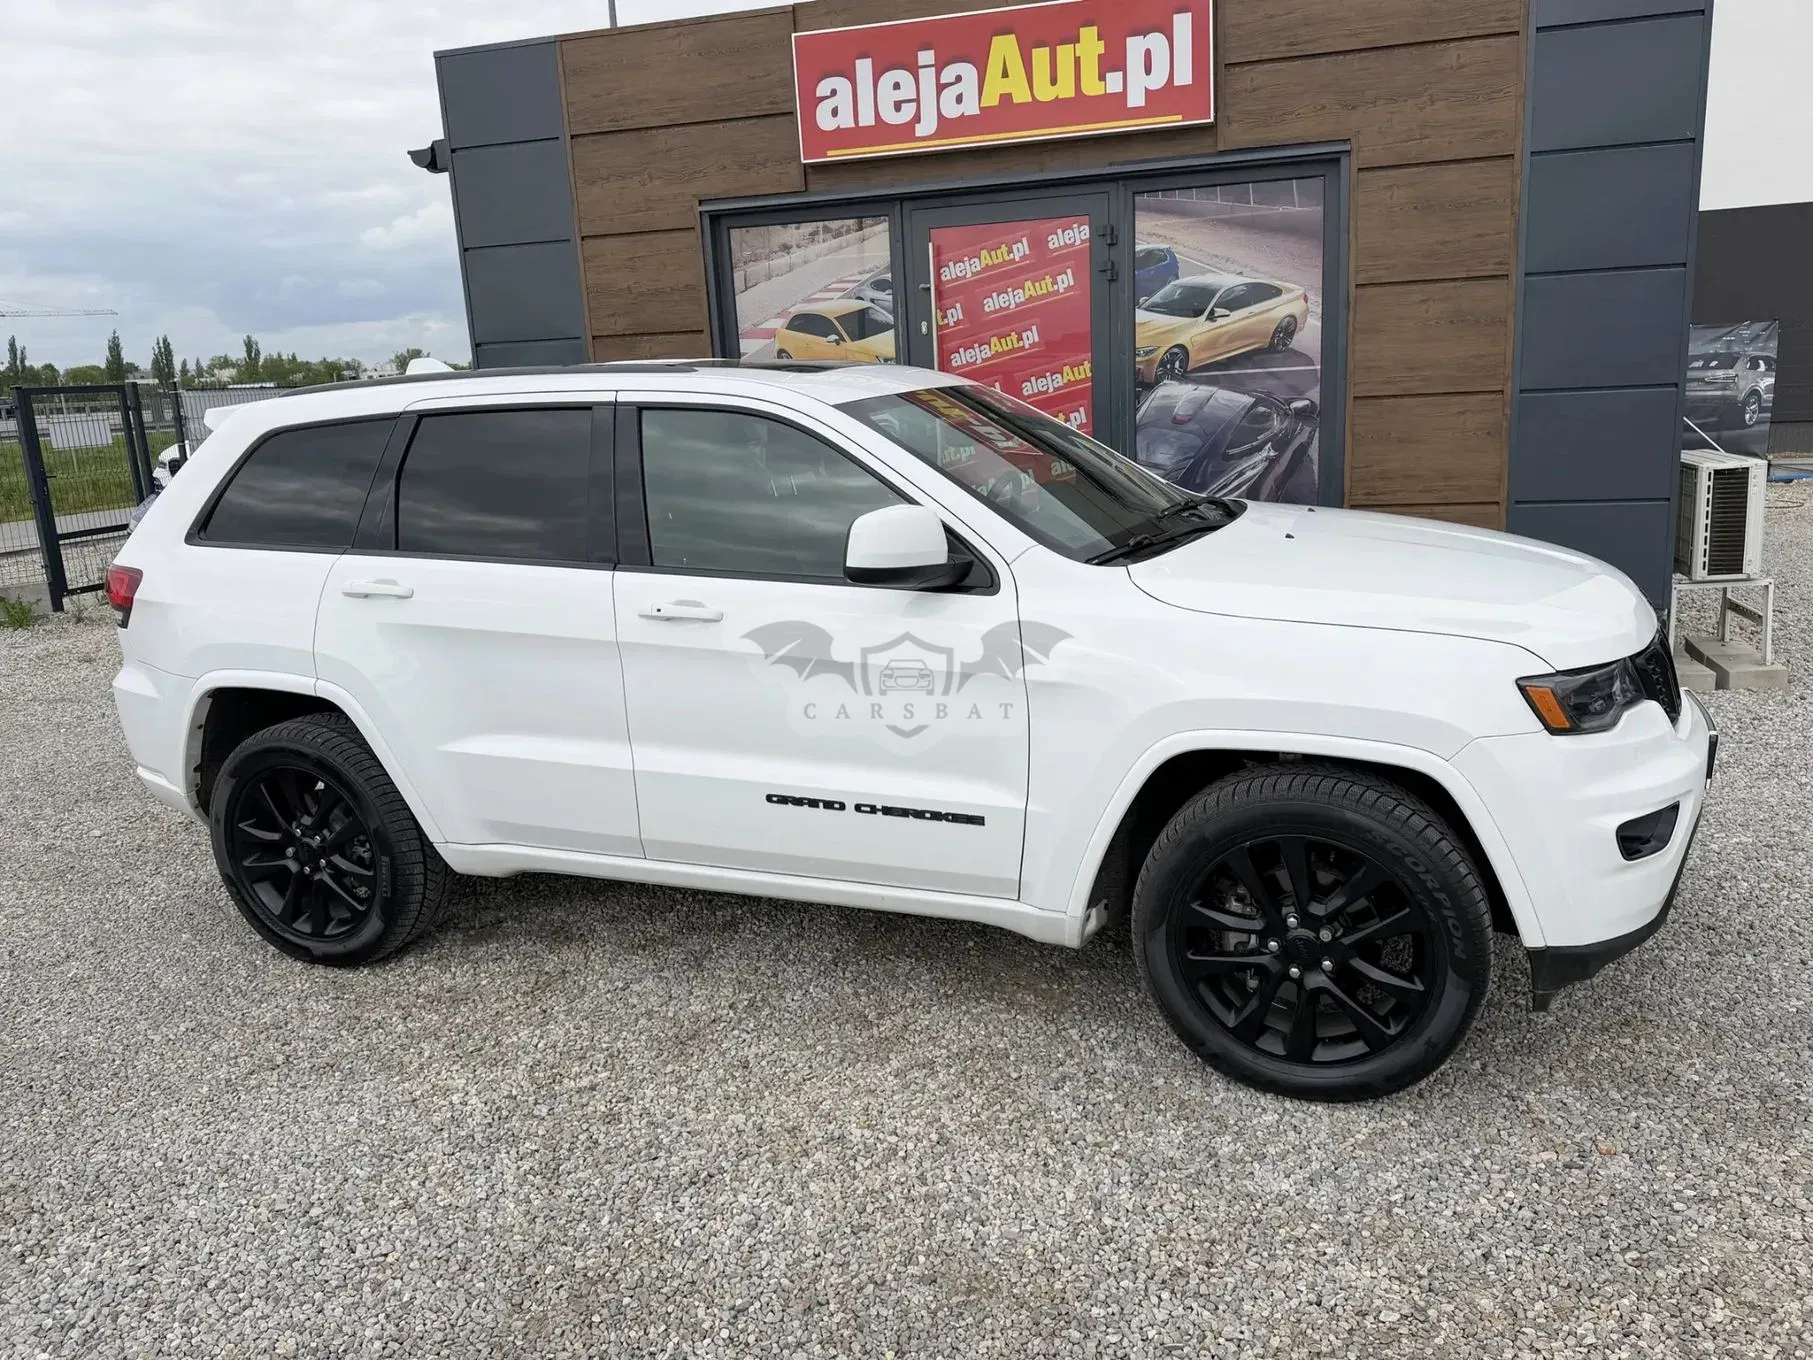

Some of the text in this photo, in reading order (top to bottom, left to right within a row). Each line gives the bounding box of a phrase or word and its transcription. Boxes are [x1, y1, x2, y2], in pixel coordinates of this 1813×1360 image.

[815, 12, 1192, 137] alejaAut.pl
[940, 237, 1030, 281] alejaAut.pl
[983, 268, 1074, 312] alejaAut.pl
[950, 325, 1040, 367] alejaAut.pl
[765, 793, 986, 827] GRAND CHEROKEE
